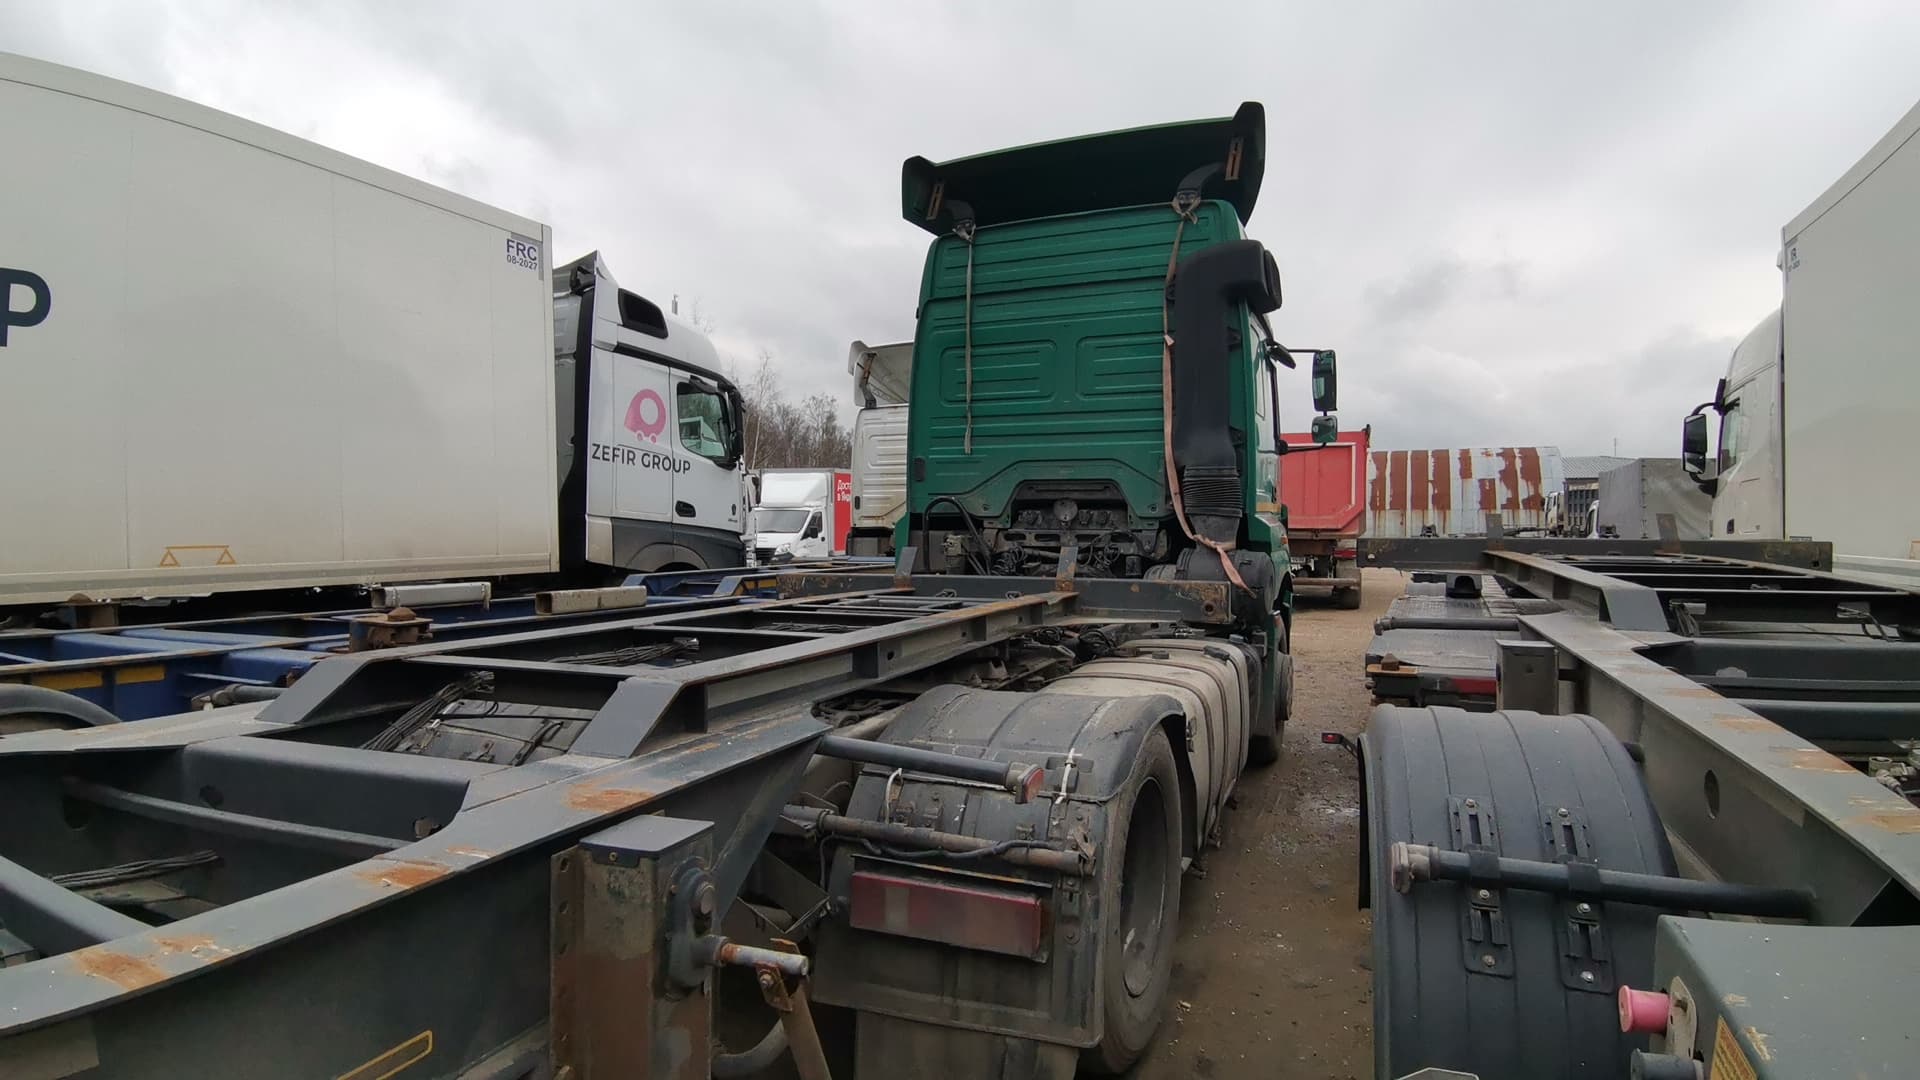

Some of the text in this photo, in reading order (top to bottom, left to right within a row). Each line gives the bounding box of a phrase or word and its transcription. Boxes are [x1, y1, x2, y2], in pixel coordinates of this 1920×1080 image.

[506, 238, 537, 261] FRC
[506, 254, 538, 270] 08-2027
[591, 443, 691, 474] ZEFIR GROUP
